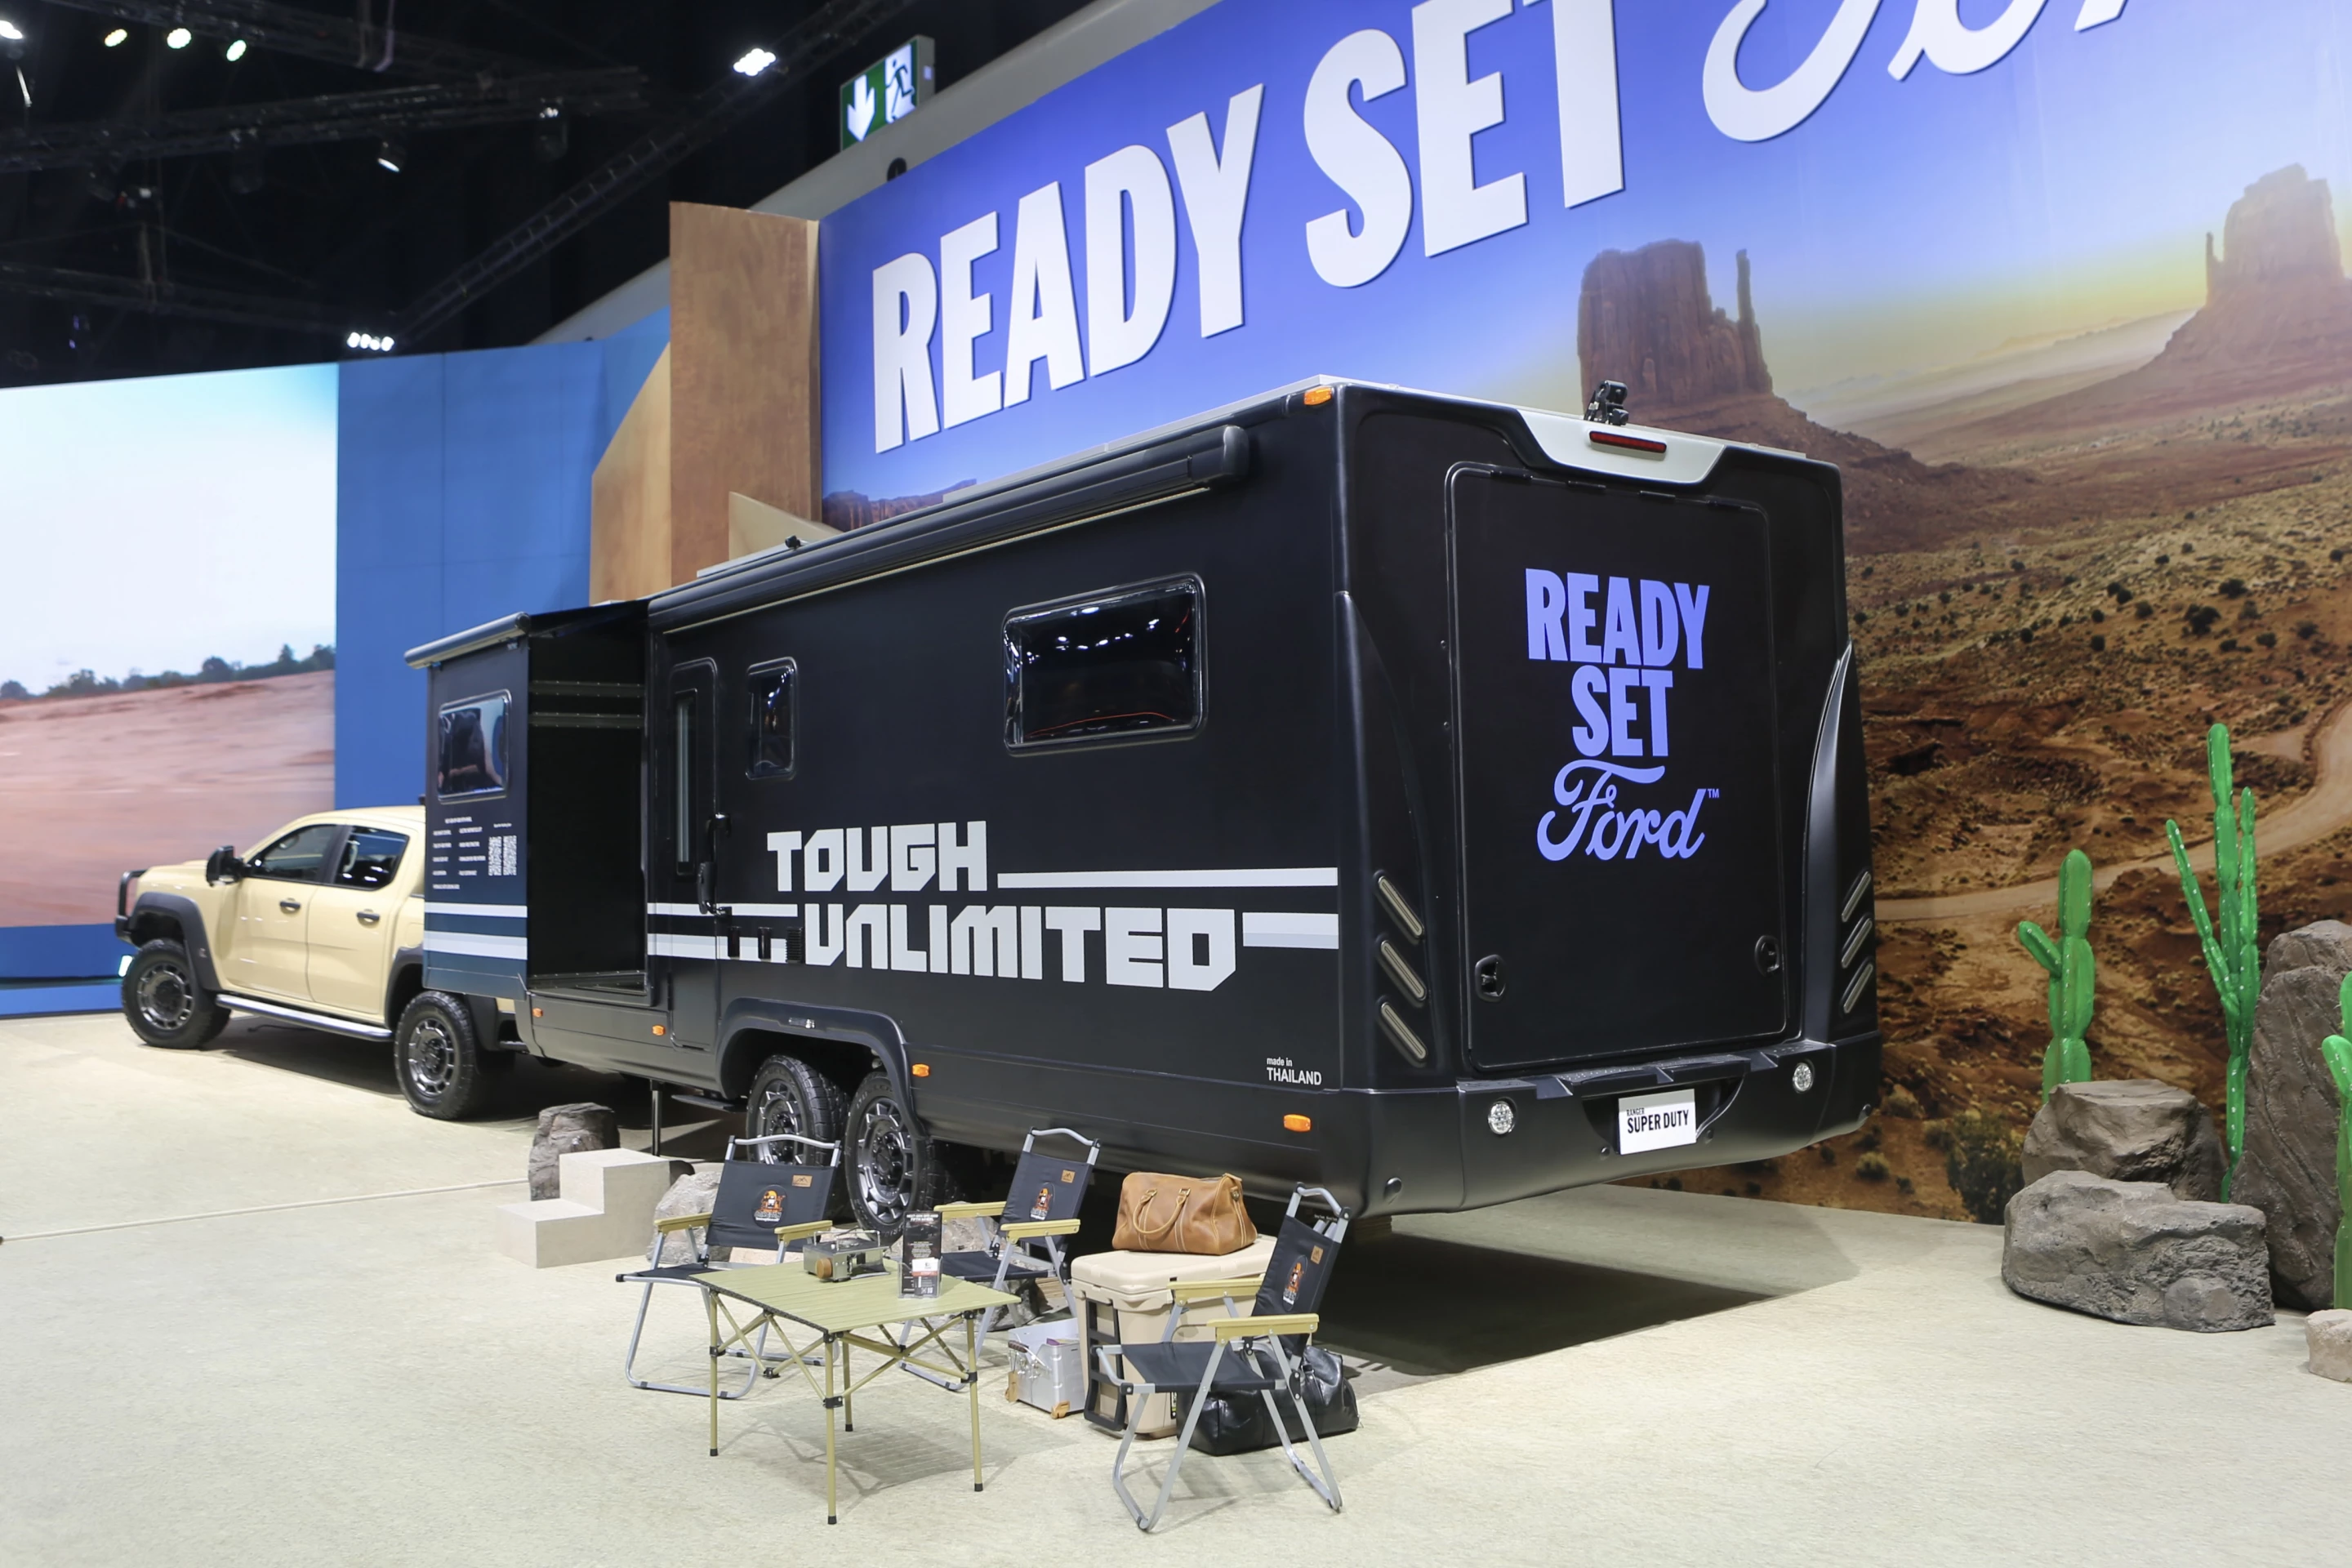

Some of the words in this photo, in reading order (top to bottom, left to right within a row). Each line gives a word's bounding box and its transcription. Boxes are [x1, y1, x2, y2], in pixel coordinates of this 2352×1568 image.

[872, 83, 1264, 453] READY
[1305, 0, 1624, 288] SET
[1525, 568, 1710, 670] READY
[1571, 665, 1673, 758] SET
[1536, 759, 1706, 862] Ford
[767, 821, 987, 892] TOUGH
[804, 903, 1236, 991] UNLIMITED
[1267, 1057, 1285, 1067] made
[1285, 1058, 1293, 1067] in
[1267, 1067, 1322, 1085] THAILAND
[1626, 1107, 1645, 1116] RANGER
[1627, 1114, 1661, 1134] SUPER
[1664, 1109, 1689, 1129] DUTY
